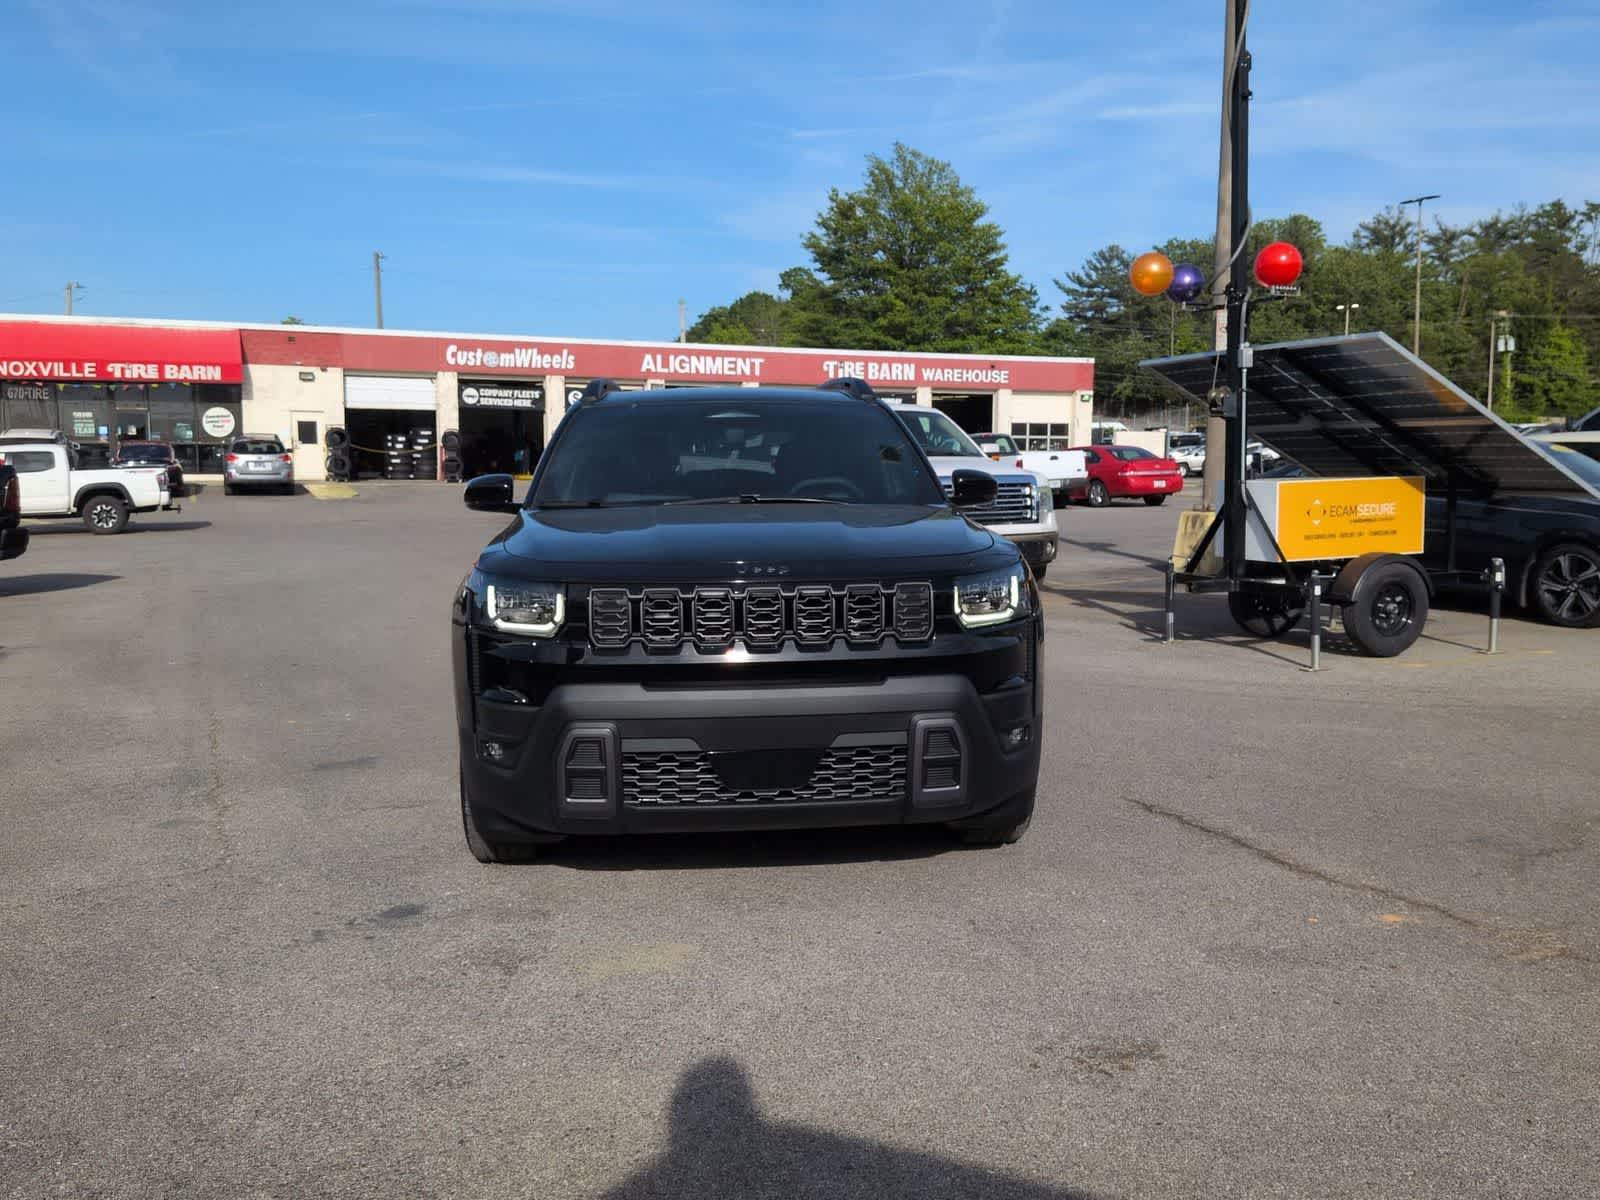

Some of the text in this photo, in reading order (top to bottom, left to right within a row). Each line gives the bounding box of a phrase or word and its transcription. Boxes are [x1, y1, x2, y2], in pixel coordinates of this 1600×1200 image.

[164, 364, 222, 380] BARN
[640, 353, 764, 376] ALIGNMENT
[868, 362, 915, 380] BARN
[921, 367, 1009, 384] WAREHOUSE
